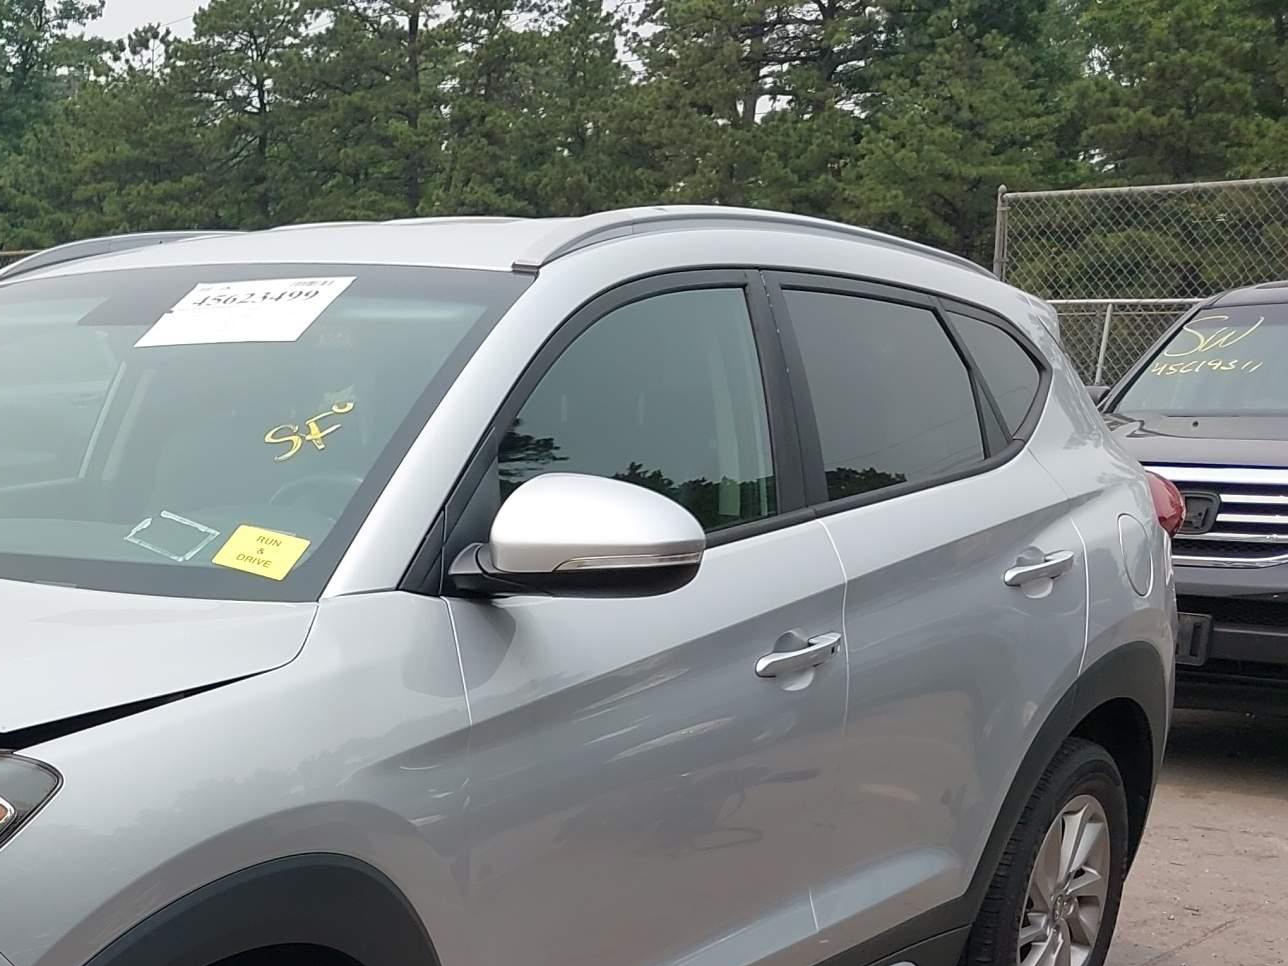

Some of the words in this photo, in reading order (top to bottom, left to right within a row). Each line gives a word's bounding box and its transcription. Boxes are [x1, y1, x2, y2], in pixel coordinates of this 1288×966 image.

[192, 289, 321, 306] 45623499
[256, 535, 282, 547] RUN
[256, 547, 265, 555] &
[236, 553, 272, 568] DRIVE
